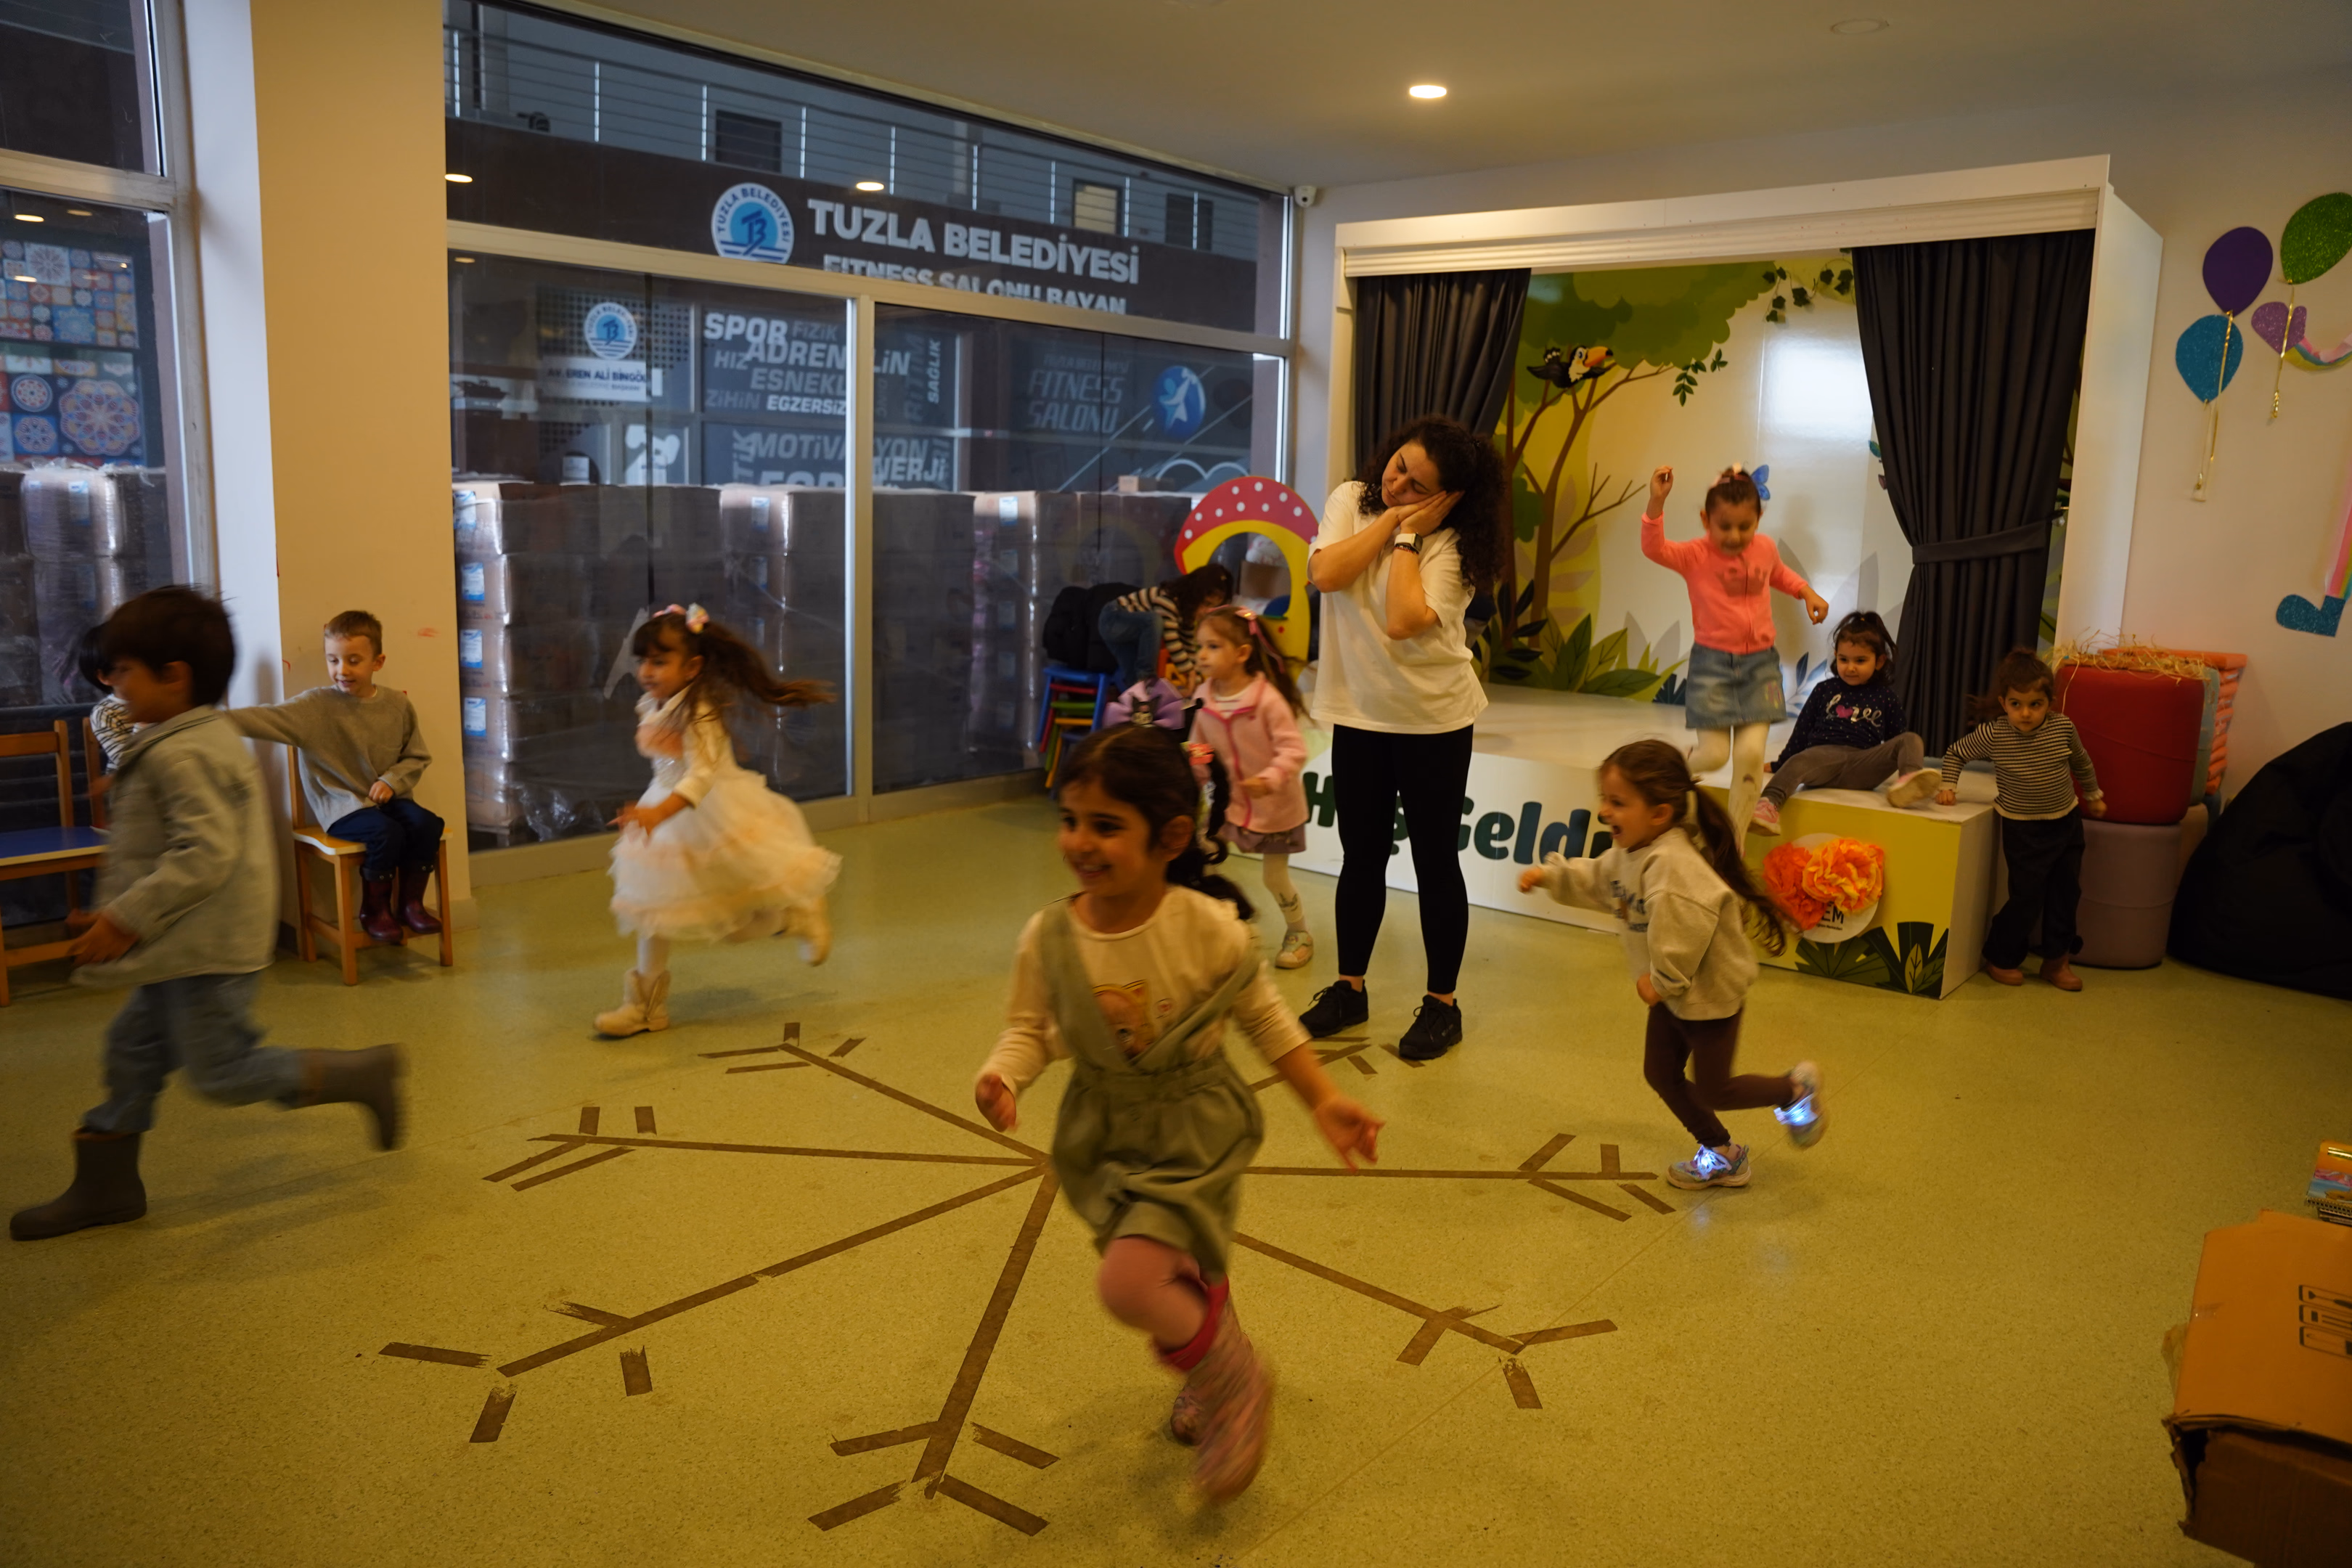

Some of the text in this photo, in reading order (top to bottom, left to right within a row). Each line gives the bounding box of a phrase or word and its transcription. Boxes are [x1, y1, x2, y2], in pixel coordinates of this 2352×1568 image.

[717, 192, 740, 234] TUZLA
[807, 198, 1139, 285] TUZLA BELEDİYESİ
[824, 254, 934, 286] FITNESS
[1047, 287, 1127, 315] BAYAN
[703, 312, 788, 346] SPOR
[751, 367, 846, 396] ESNEKL
[926, 338, 941, 404] SAĞLIK
[1028, 368, 1126, 404] FITNESS
[1026, 401, 1120, 434] SALONU
